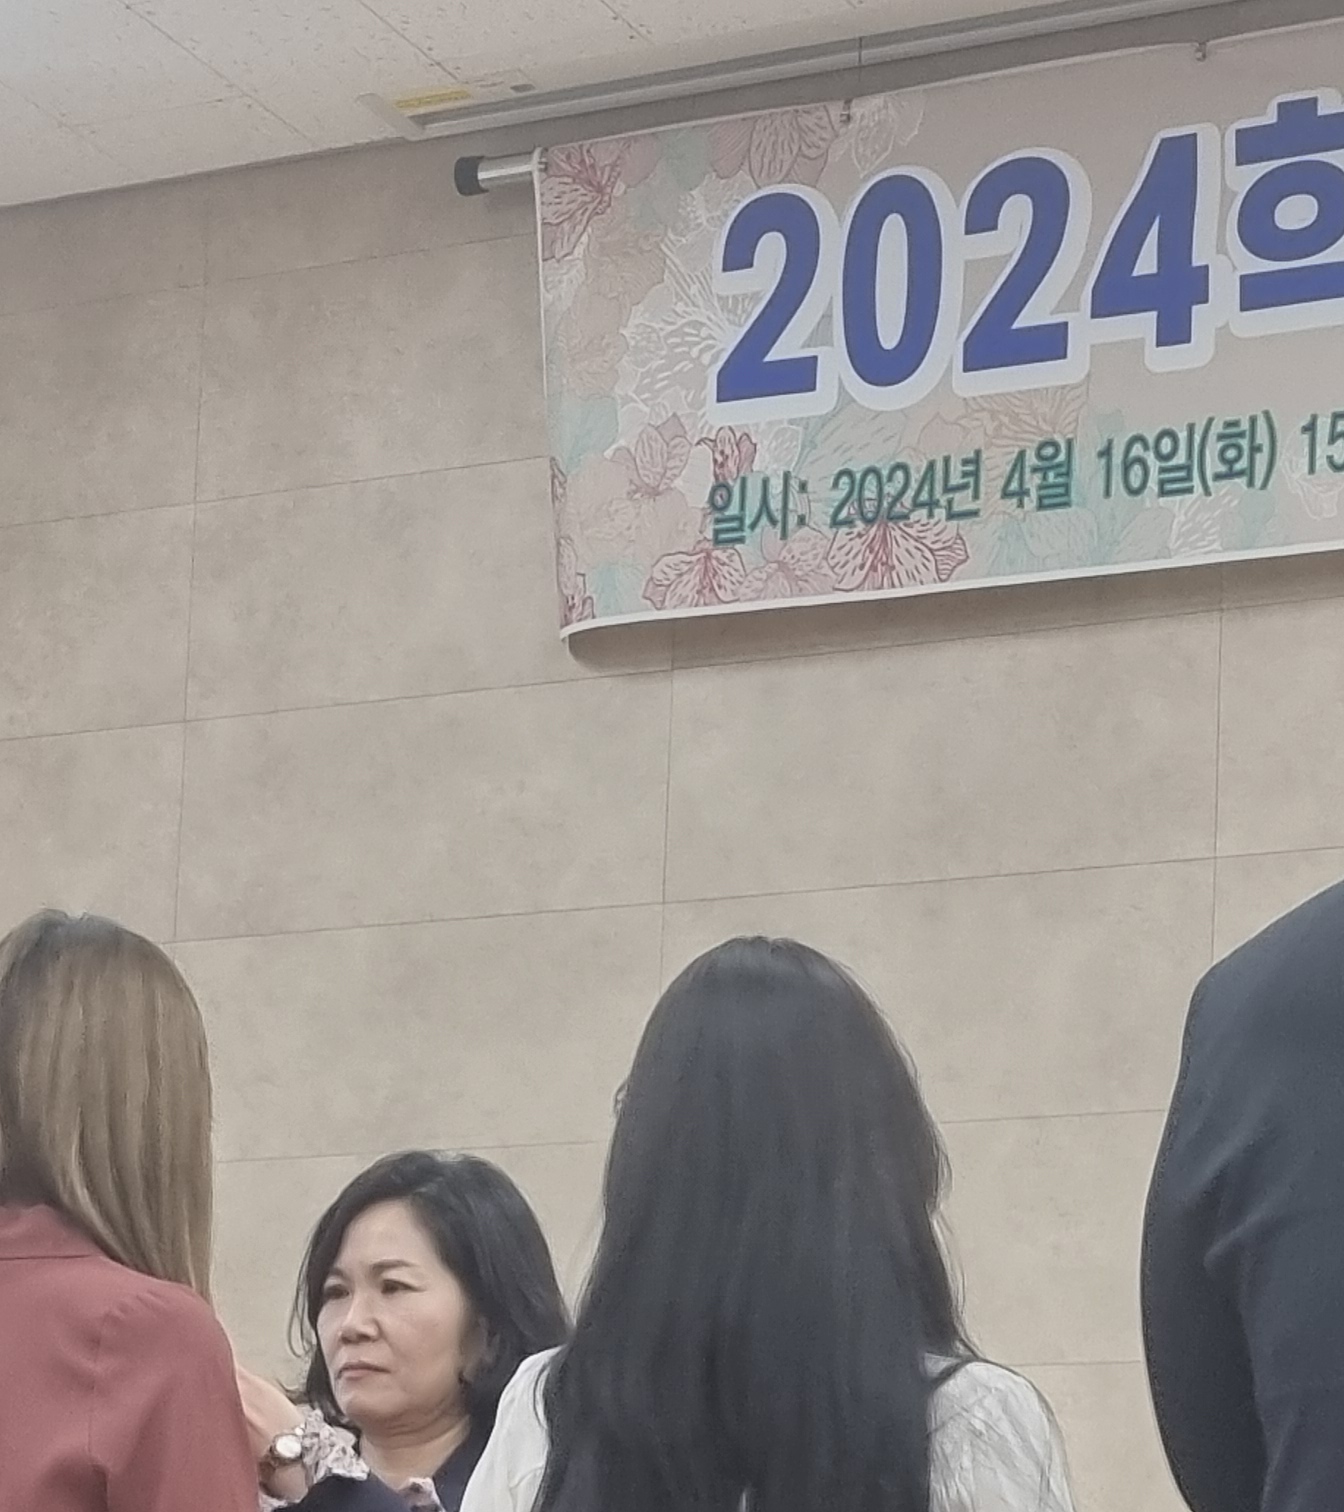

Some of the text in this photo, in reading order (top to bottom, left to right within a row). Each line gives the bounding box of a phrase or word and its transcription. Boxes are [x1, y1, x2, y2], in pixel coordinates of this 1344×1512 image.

[709, 470, 808, 547] 일시:
[829, 448, 983, 530] 2024년
[1000, 437, 1075, 512] 4월
[1096, 409, 1278, 499] 16일(화)
